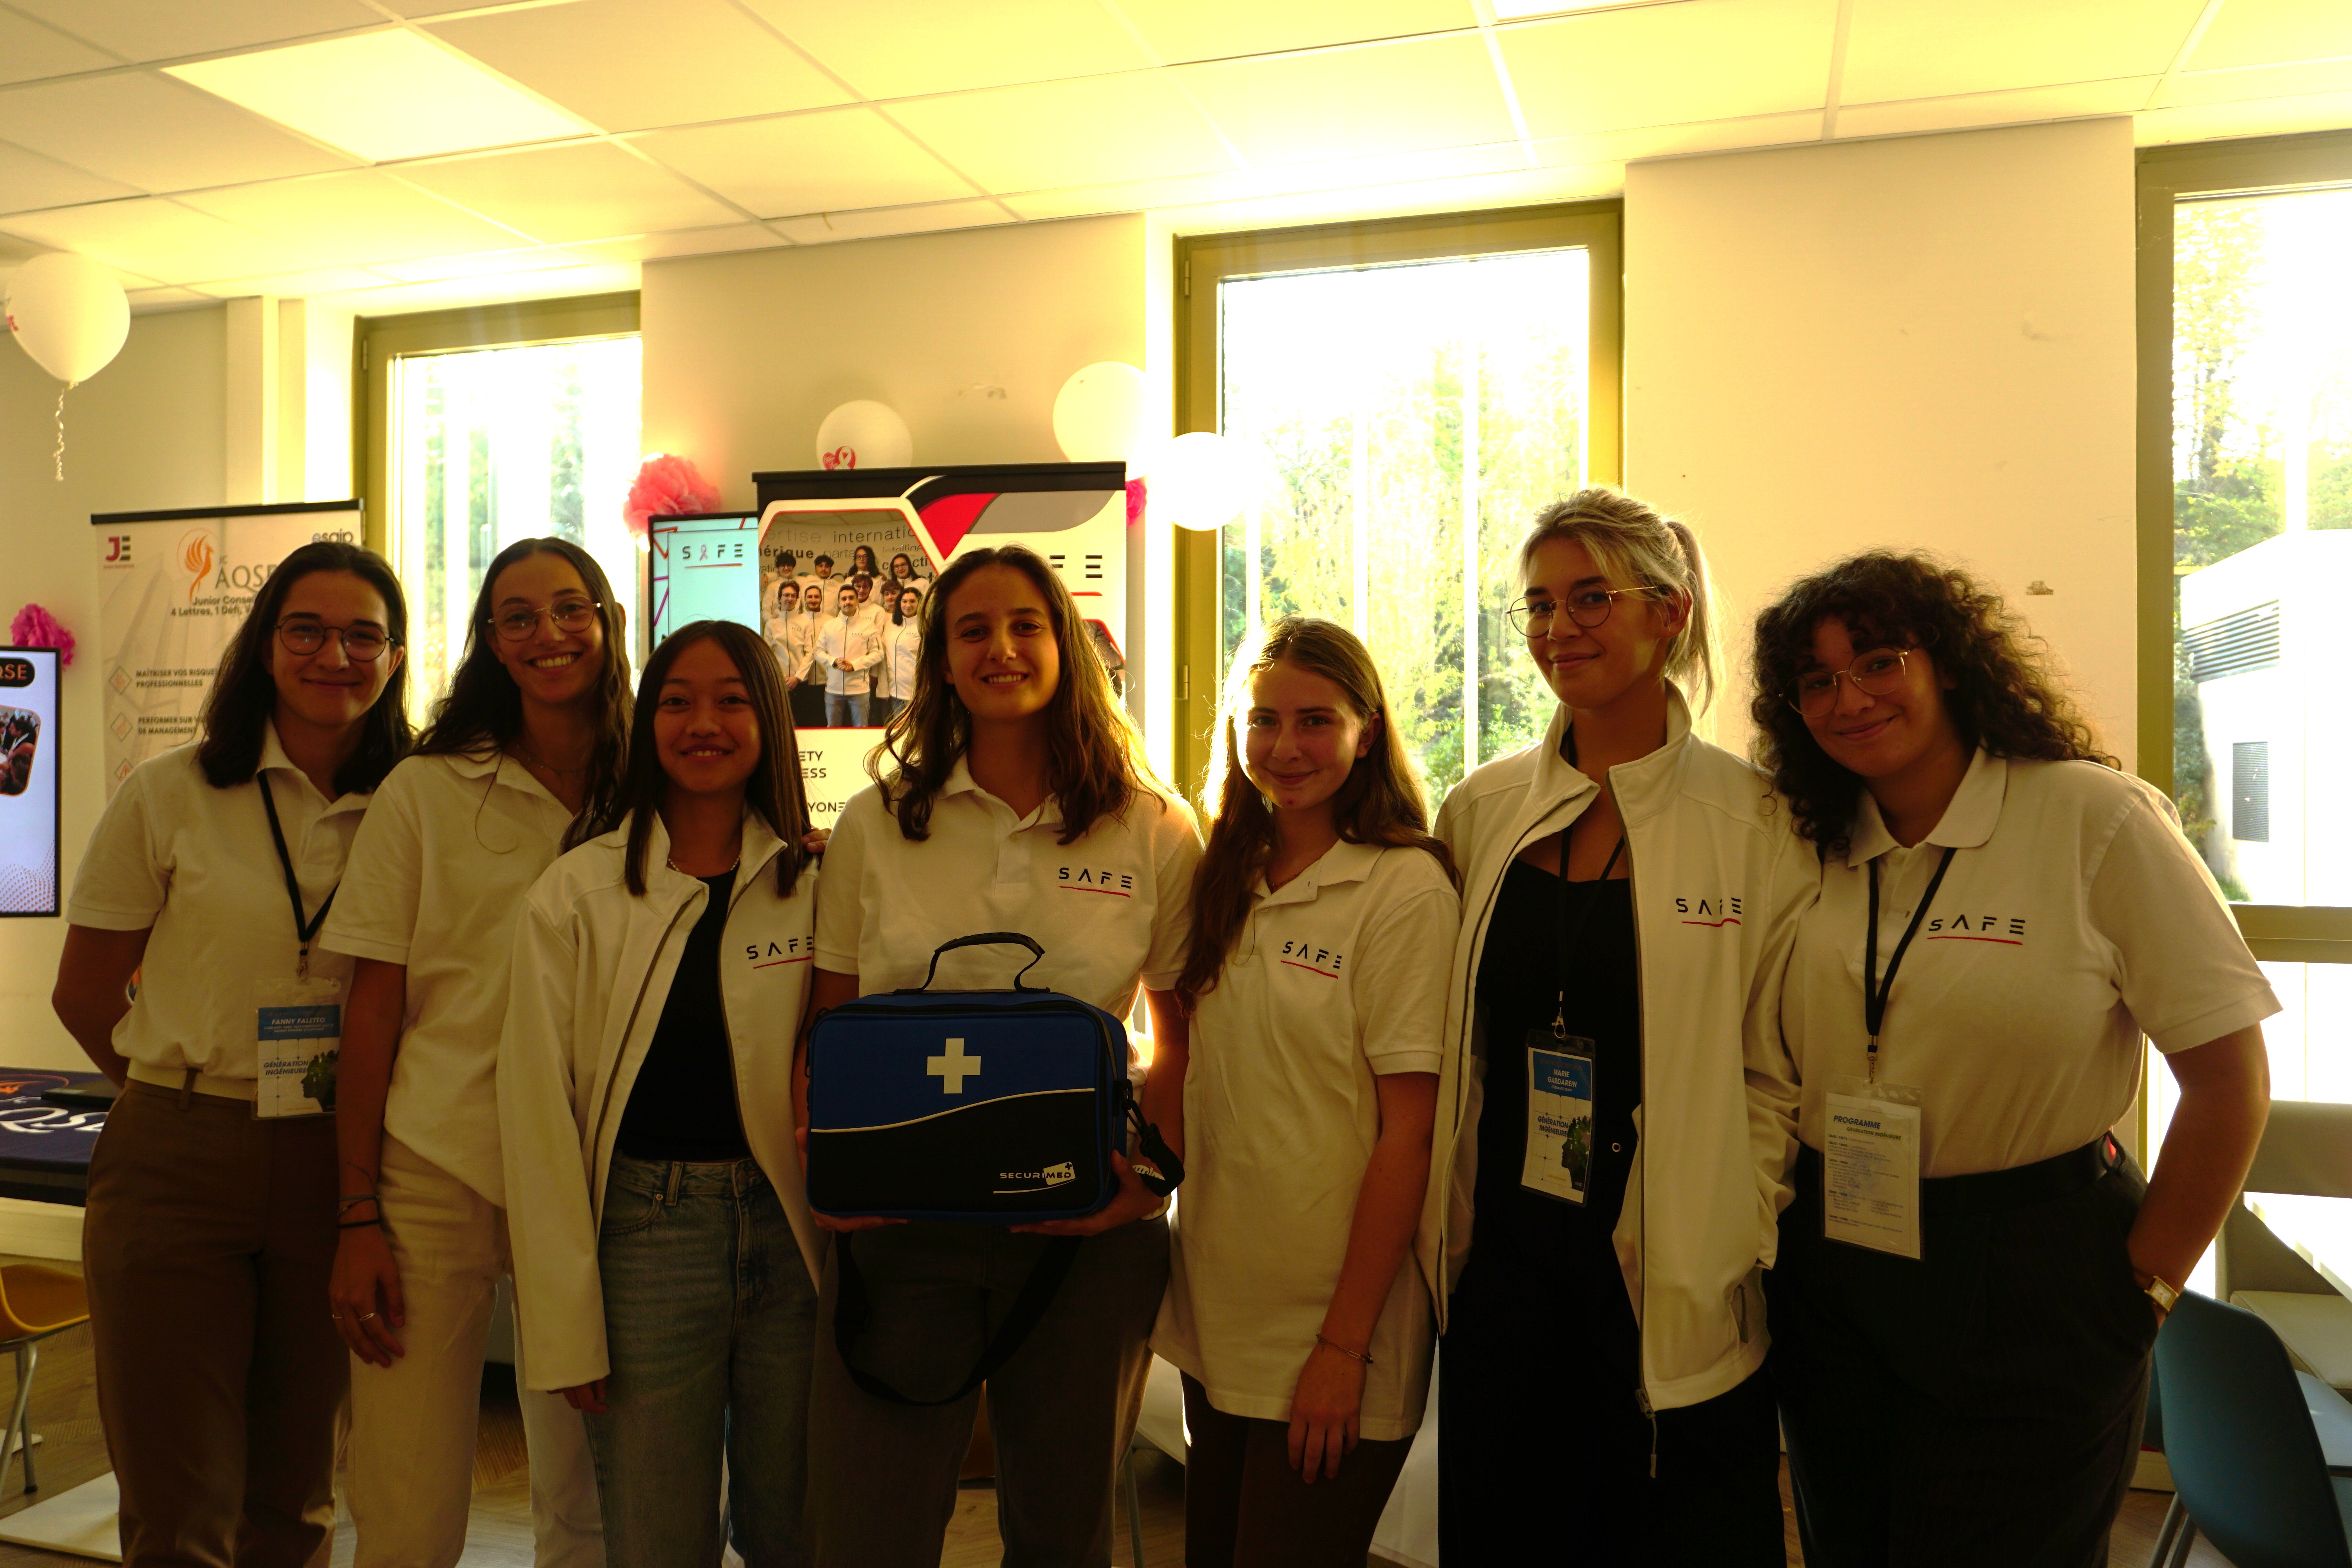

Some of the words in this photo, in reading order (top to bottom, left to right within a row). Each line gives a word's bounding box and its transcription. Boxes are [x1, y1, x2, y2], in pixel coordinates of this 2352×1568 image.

[193, 595, 220, 605] Junior
[179, 607, 212, 617] Lettres,
[138, 716, 178, 724] PERFORMER
[1059, 867, 1132, 889] SAFE
[1929, 914, 2025, 935] SAFE
[746, 936, 813, 960] SAFE
[1283, 942, 1342, 969] SAFE
[1553, 1069, 1570, 1078] MARIE
[1548, 1076, 1577, 1087] GARDAREIN
[1538, 1115, 1568, 1129] GÉNÉRATION
[1833, 1115, 1881, 1129] PROGRAMME
